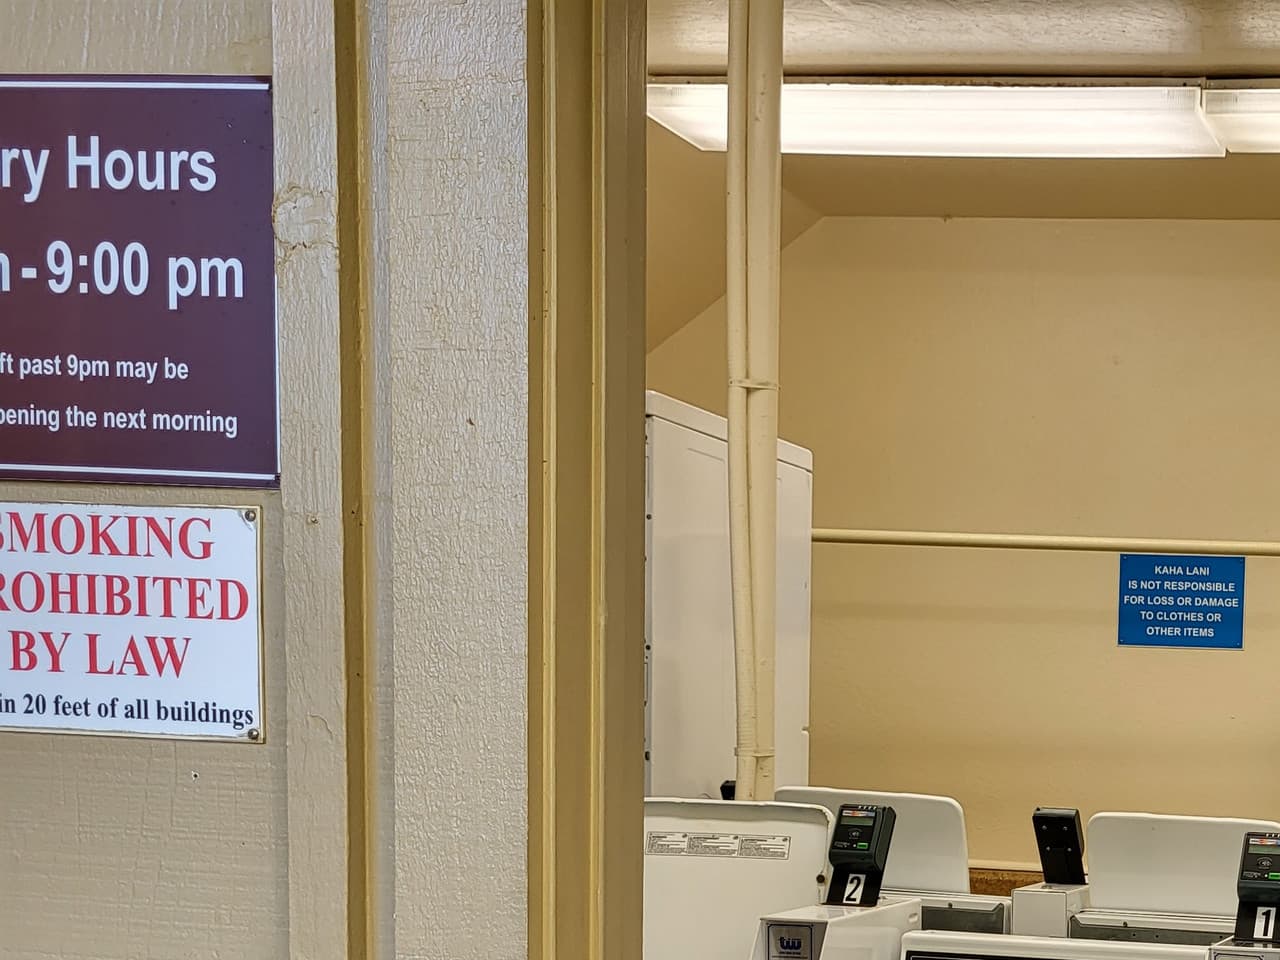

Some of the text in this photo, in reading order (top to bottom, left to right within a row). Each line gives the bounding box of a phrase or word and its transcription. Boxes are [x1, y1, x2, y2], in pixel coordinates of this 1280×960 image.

[67, 134, 217, 192] Hours
[46, 240, 150, 296] 9:00
[168, 256, 244, 310] pm
[20, 355, 61, 379] past
[67, 354, 109, 381] 9pm
[116, 359, 157, 384] may
[164, 357, 189, 380] be
[66, 406, 97, 428] the
[104, 409, 146, 429] next
[153, 409, 237, 438] morning
[0, 511, 215, 560] MOKING
[1155, 565, 1209, 576] KAHA LANI
[1128, 580, 1235, 592] IS NOT RESPONSIBLE
[1124, 595, 1239, 607] FOR LOSS OR DAMAGE
[1140, 611, 1221, 622] TO CLOTHES OR
[1146, 626, 1214, 637] OTHER ITEMS
[8, 630, 192, 678] BY LAW
[23, 693, 46, 715] 20
[53, 695, 91, 717] feet
[100, 697, 119, 718] of
[124, 699, 149, 720] all
[156, 701, 254, 729] buildings
[846, 876, 861, 902] 2
[1260, 909, 1271, 937] 1
